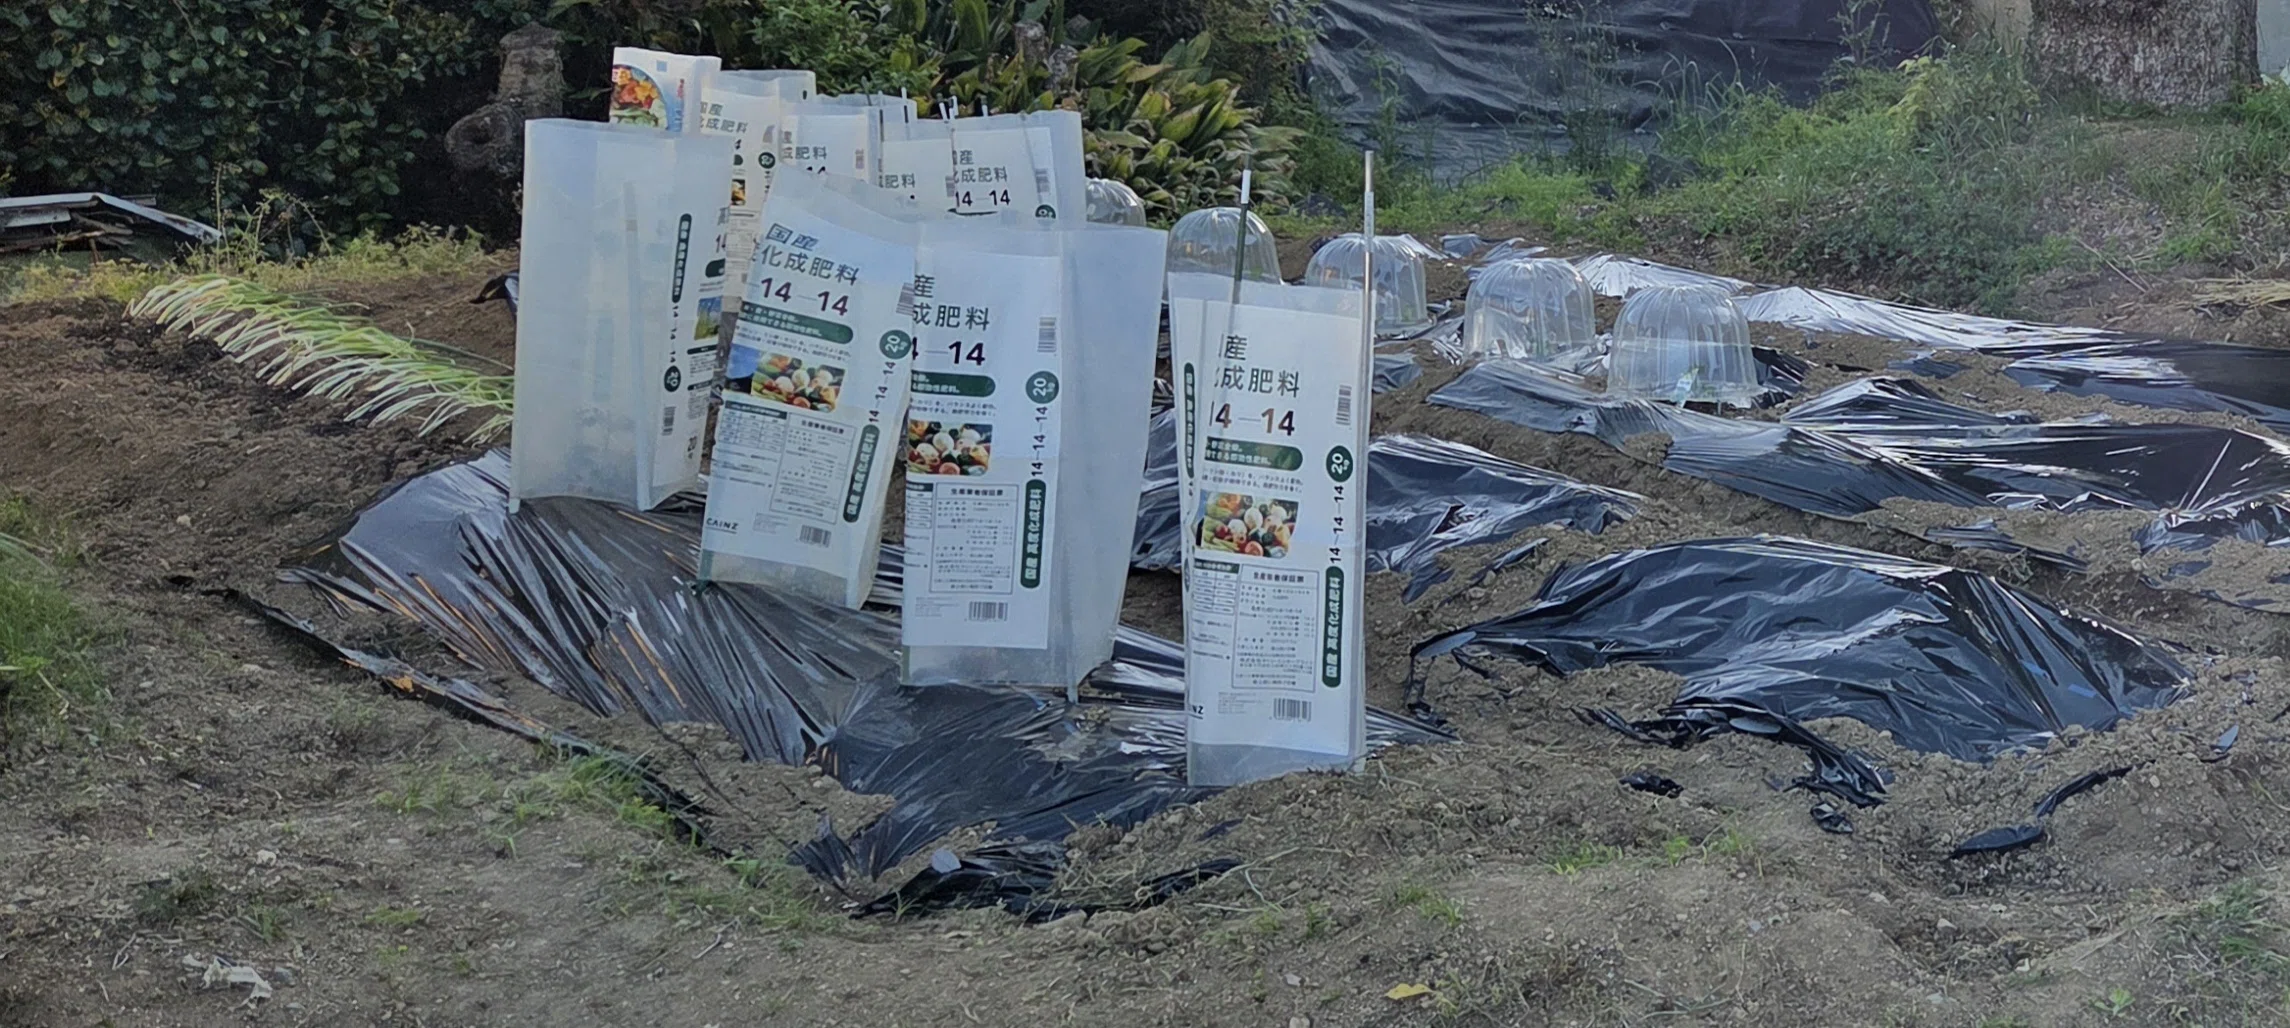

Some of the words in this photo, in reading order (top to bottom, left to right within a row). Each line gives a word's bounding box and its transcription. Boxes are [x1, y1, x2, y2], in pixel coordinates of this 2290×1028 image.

[765, 223, 818, 252] 国産
[885, 334, 900, 353] 20
[1032, 377, 1047, 397] 20
[1331, 453, 1344, 475] 20
[706, 517, 739, 531] CAINZ
